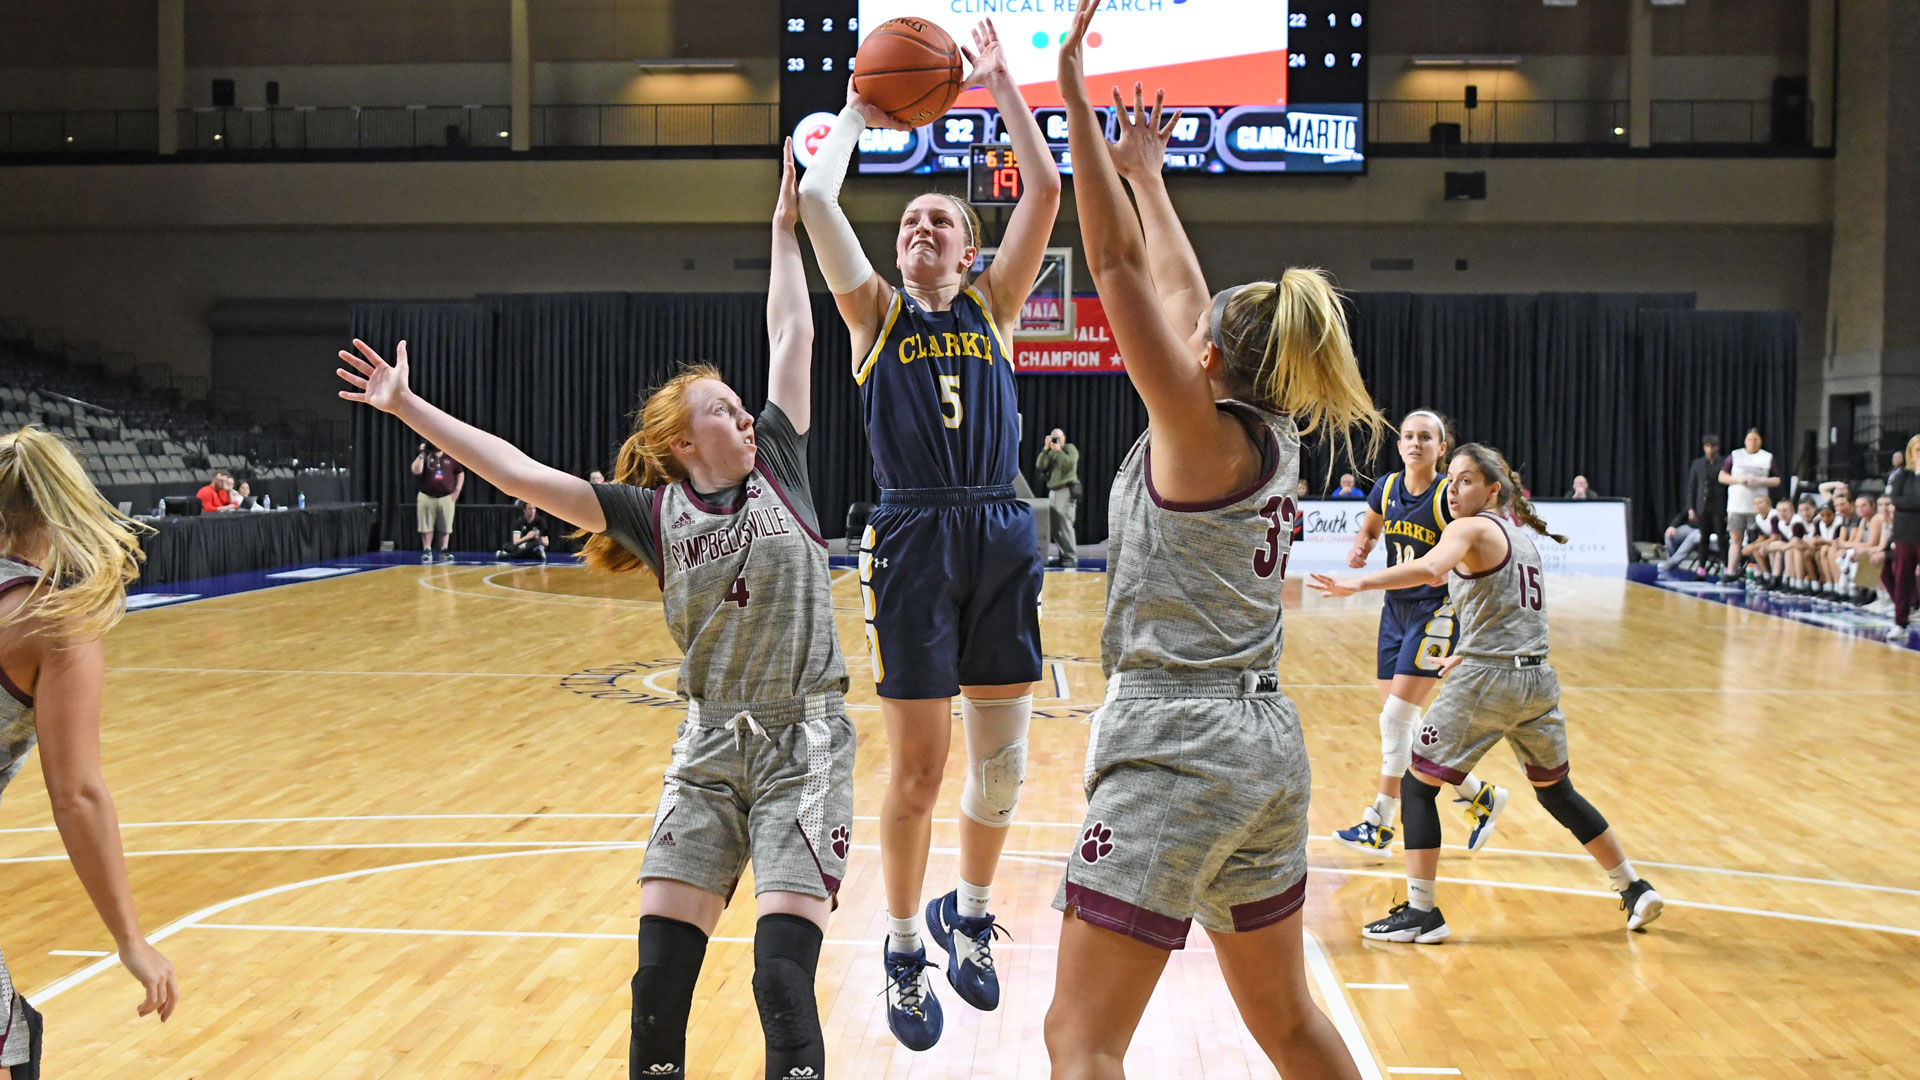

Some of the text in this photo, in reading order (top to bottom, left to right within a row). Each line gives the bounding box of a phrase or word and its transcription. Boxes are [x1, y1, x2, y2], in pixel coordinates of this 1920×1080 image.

[951, 0, 1044, 13] CLINICAL
[787, 18, 805, 32] 32
[822, 18, 833, 32] 2
[1289, 13, 1362, 28] 22 1 0
[787, 57, 805, 71] 33
[822, 57, 833, 71] 2
[1288, 53, 1361, 68] 24 0 7
[945, 118, 974, 143] 32
[993, 169, 1018, 198] 19
[1021, 302, 1059, 318] NAIA
[898, 332, 993, 366] CLARKE
[1018, 350, 1100, 367] CHAMPION
[938, 375, 964, 429] 5
[672, 519, 696, 530] adidas
[1306, 510, 1348, 534] South
[1384, 520, 1436, 546] LARKE
[671, 505, 790, 573] CAMPBELLSVILLE
[723, 575, 750, 609] 4
[1517, 562, 1542, 611] 15
